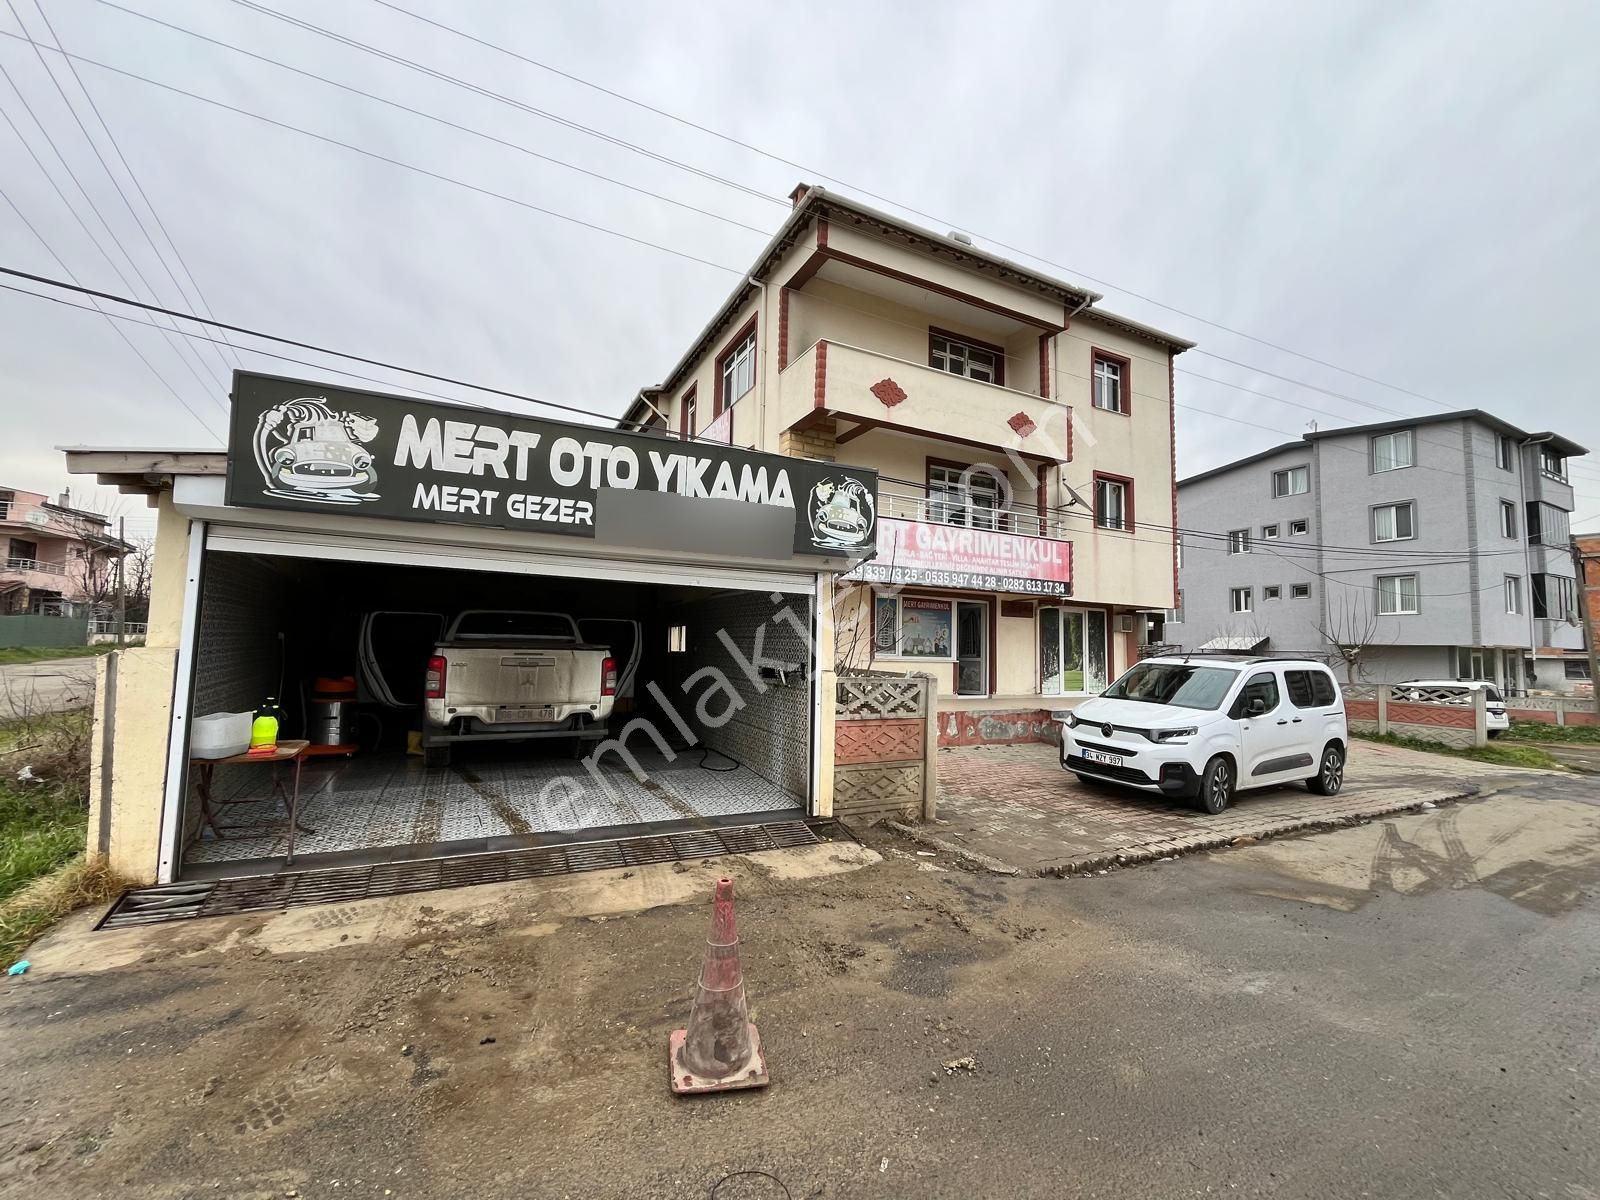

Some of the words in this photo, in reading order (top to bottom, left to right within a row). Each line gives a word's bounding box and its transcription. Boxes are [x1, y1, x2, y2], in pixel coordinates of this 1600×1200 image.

[393, 413, 541, 481] MERT
[549, 436, 640, 490] OTO
[648, 451, 795, 508] YIKAMA
[412, 482, 500, 516] MERT
[506, 493, 594, 526] GEZER
[877, 521, 908, 550] RT
[865, 566, 886, 579] 339
[904, 569, 918, 582] 25
[925, 571, 950, 584] 0535
[951, 573, 970, 585] 947
[970, 575, 984, 587] 44
[984, 576, 997, 588] 28
[1002, 578, 1025, 591] 0282
[1026, 580, 1042, 592] 613
[1043, 581, 1053, 593] 17
[1054, 582, 1066, 594] 34
[1108, 756, 1120, 765] 997
